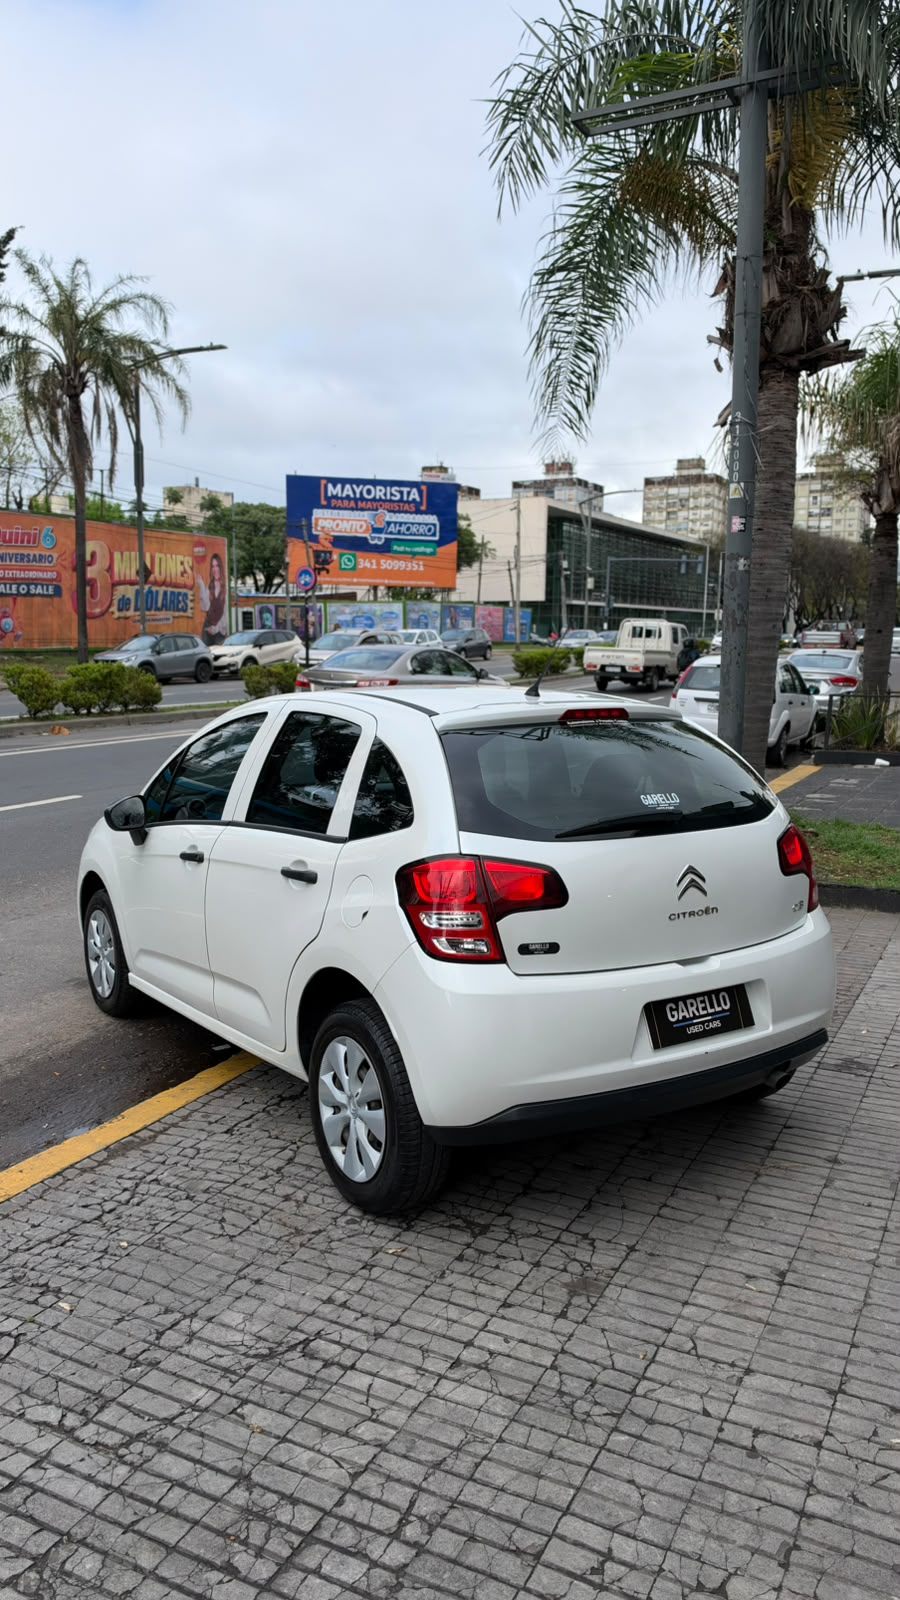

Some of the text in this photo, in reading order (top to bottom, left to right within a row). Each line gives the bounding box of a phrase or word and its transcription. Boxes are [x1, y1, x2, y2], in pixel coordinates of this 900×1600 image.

[327, 482, 420, 502] MAYORISTA
[331, 499, 416, 512] PARA MAYORISTAS
[316, 519, 435, 535] PRONTO AHORRO
[0, 525, 56, 549] uini 6
[0, 552, 54, 565] NIVERSARIO
[358, 559, 424, 571] 341 5099351
[74, 540, 112, 619] 3
[0, 584, 55, 595] ALE O SALE
[117, 594, 131, 612] de
[640, 792, 680, 805] GARELLO
[665, 991, 731, 1022] GARELLO
[686, 1020, 722, 1034] USED CARS
